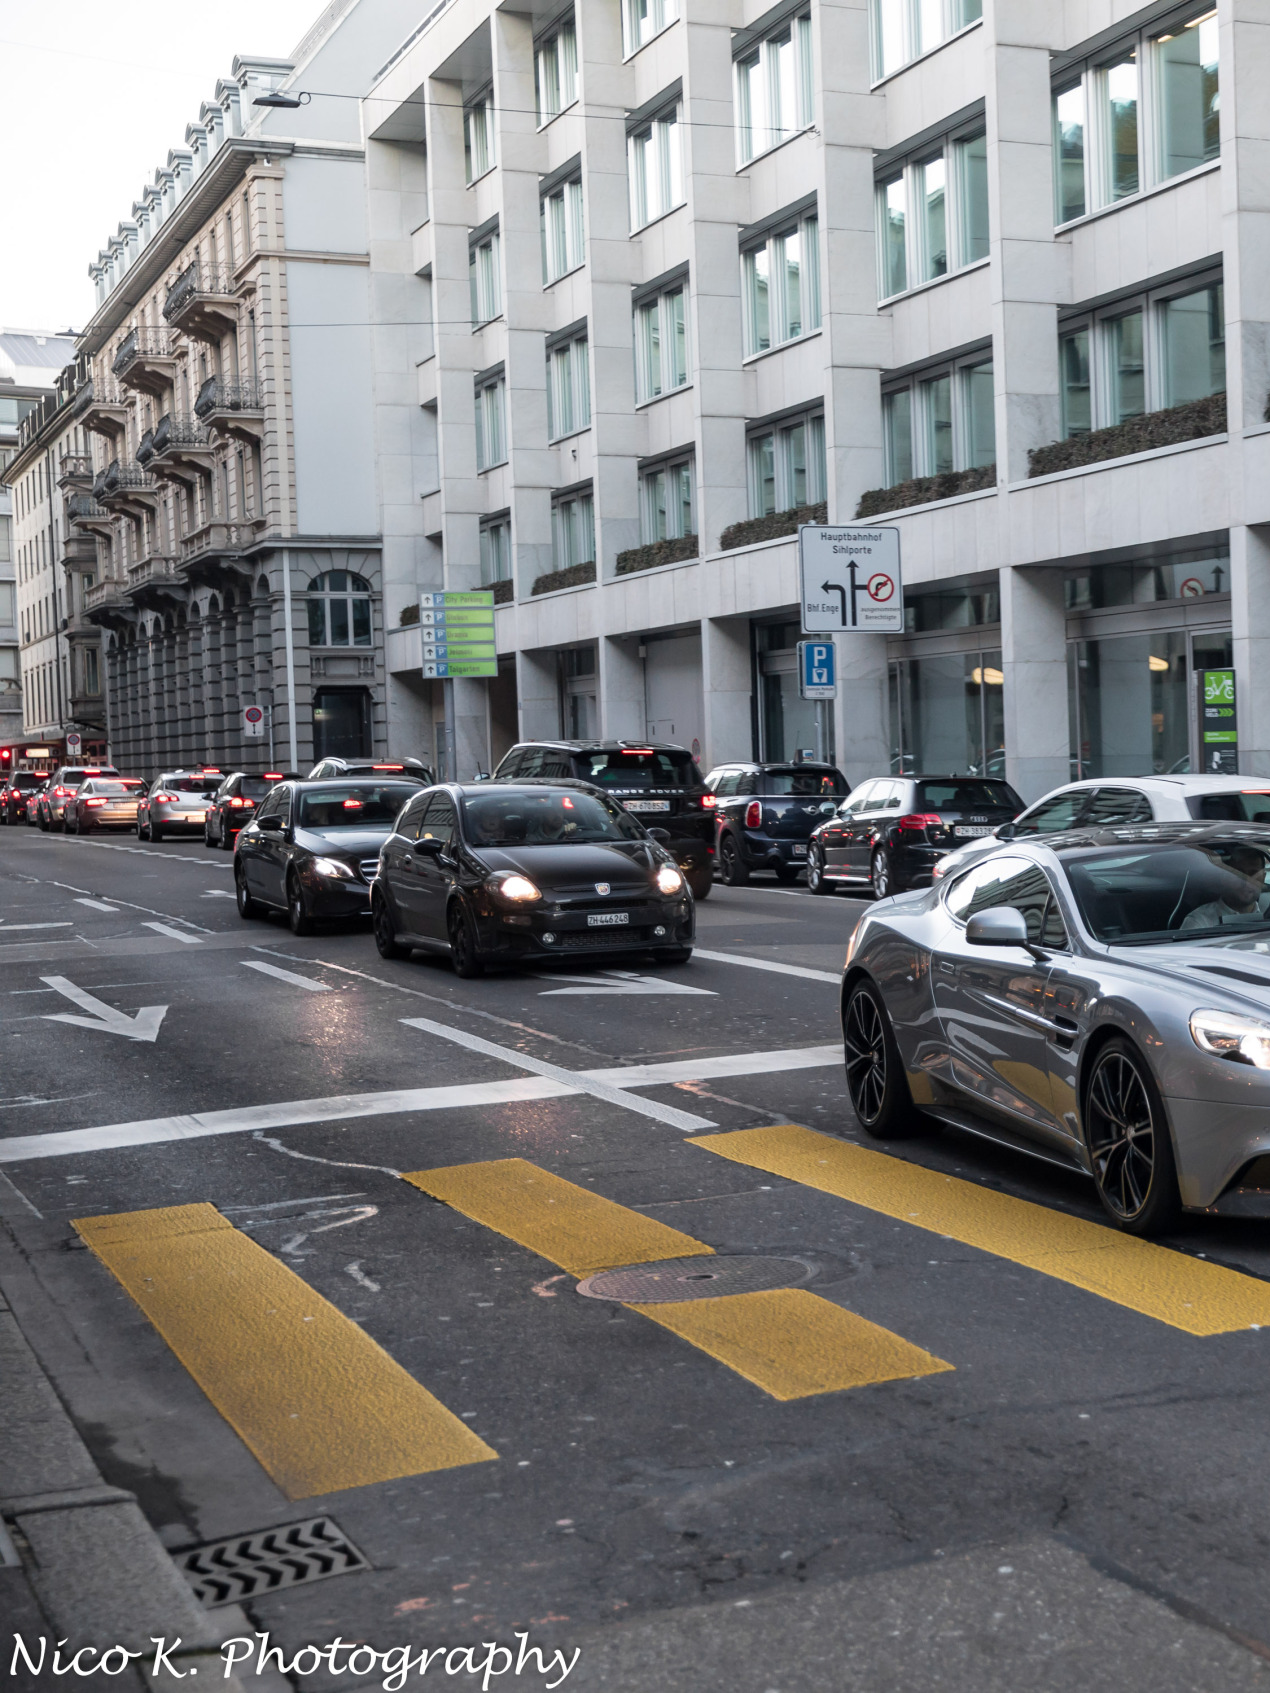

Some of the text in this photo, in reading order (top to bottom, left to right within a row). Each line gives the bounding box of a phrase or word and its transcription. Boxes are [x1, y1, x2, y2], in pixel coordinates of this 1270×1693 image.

[820, 532, 882, 542] Hauptbahnhof
[832, 545, 872, 555] Sihlporte
[445, 596, 458, 604] City
[460, 596, 484, 604] Parking
[813, 647, 827, 667] P
